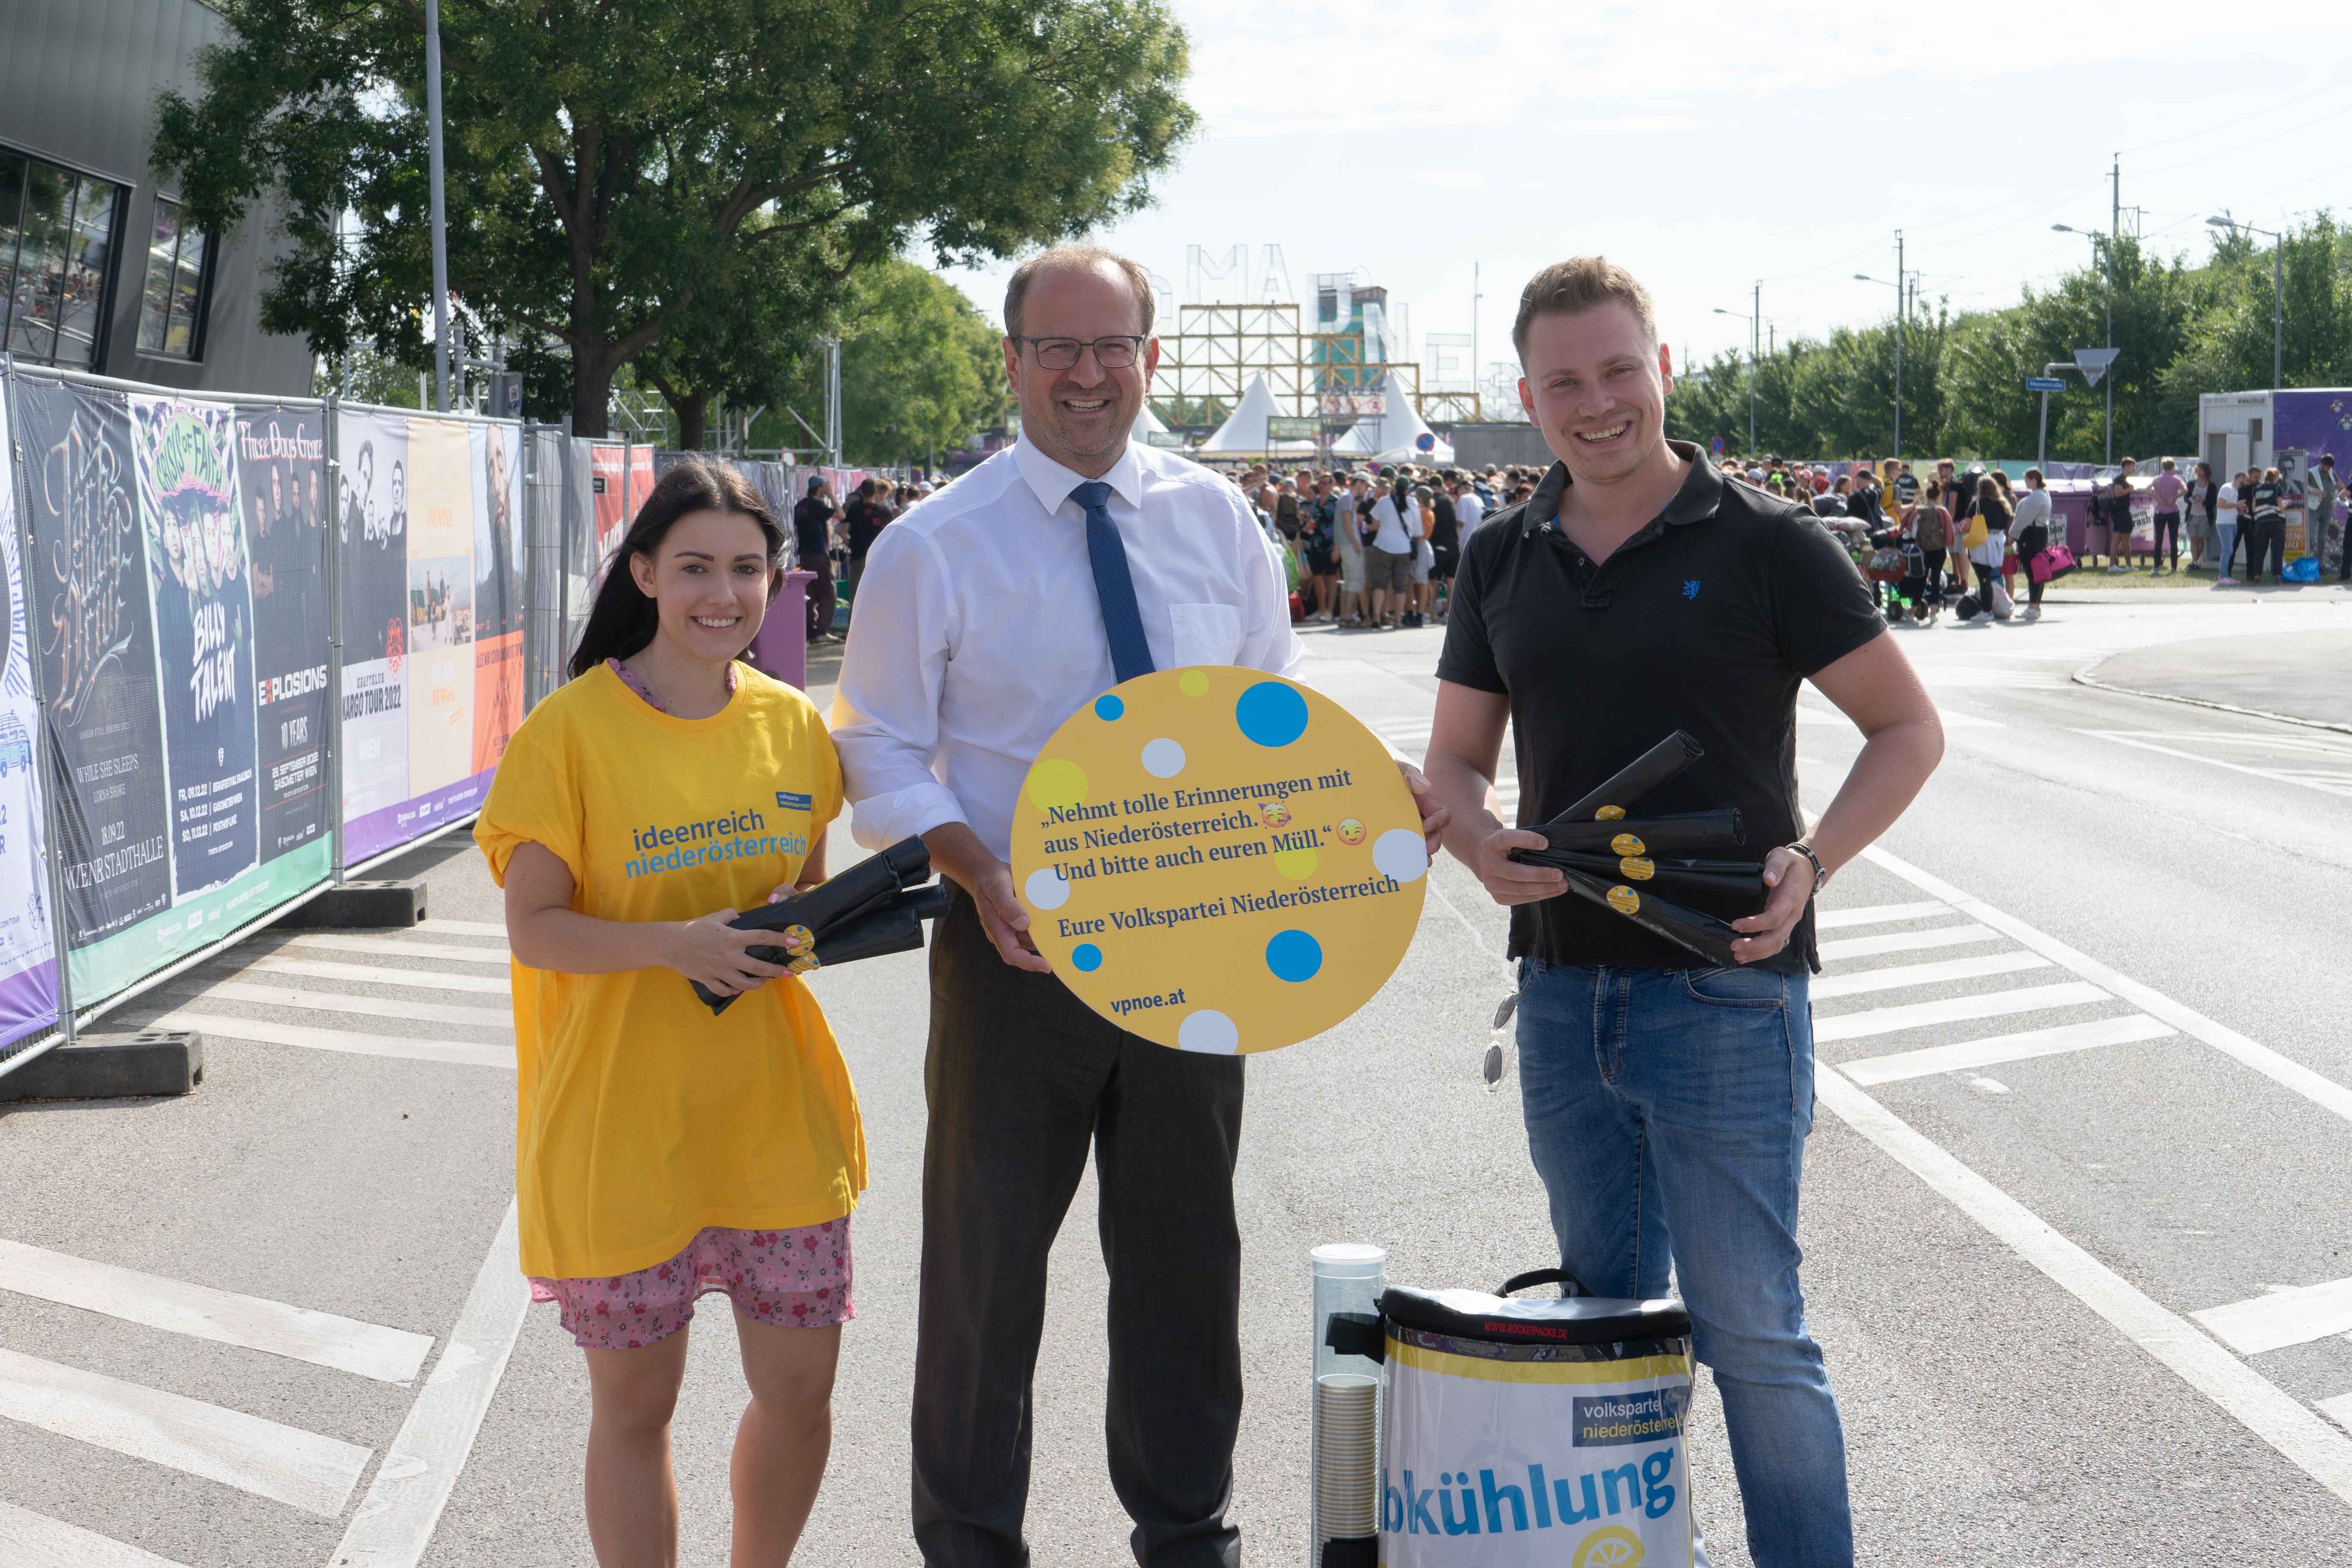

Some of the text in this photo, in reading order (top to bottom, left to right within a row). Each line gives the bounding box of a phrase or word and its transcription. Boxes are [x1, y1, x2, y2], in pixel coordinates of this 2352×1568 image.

[156, 422, 222, 493] CRISIS OF FAITH
[193, 601, 225, 667] BILLY
[190, 640, 236, 724] TALENT
[259, 664, 328, 707] EXPLOSIONS
[357, 672, 385, 689] KRAFTKLUB
[342, 684, 401, 722] KARGO TOUR 2022
[281, 716, 308, 750] 10 YEARS
[358, 735, 380, 761] WIEN
[76, 754, 139, 784] WHILE SHE SLEEPS
[274, 764, 318, 791] GASOMETER WIEN
[279, 756, 306, 775] SEPTEMBER
[306, 751, 319, 765] 2022
[178, 788, 188, 802] FR,
[188, 783, 208, 800] 09.12.22
[1041, 768, 1352, 829] „Nehmt tolle Erinnerungen mit
[180, 810, 189, 823] SA,
[189, 804, 208, 820] 10.12.22
[633, 808, 765, 852] ideenreich
[1044, 810, 1259, 854] aus Niederösterreich.
[101, 821, 125, 845] 18.09.22
[182, 829, 192, 842] SO,
[192, 824, 208, 840] 11.12.22
[103, 835, 164, 880] STADTHALLE
[624, 831, 807, 879] niederösterreich
[1053, 858, 1097, 881] Und
[1100, 855, 1150, 876] bitte
[1155, 845, 1204, 869] auch
[1208, 840, 1268, 861] euren
[1057, 874, 1401, 938] Eure Volkspartei Niederösterreich
[1110, 988, 1186, 1017] vpnoe.at
[1484, 1321, 1568, 1339] WWW.ROCKETPACKS.DE
[1383, 1447, 1676, 1536] bkühlung
